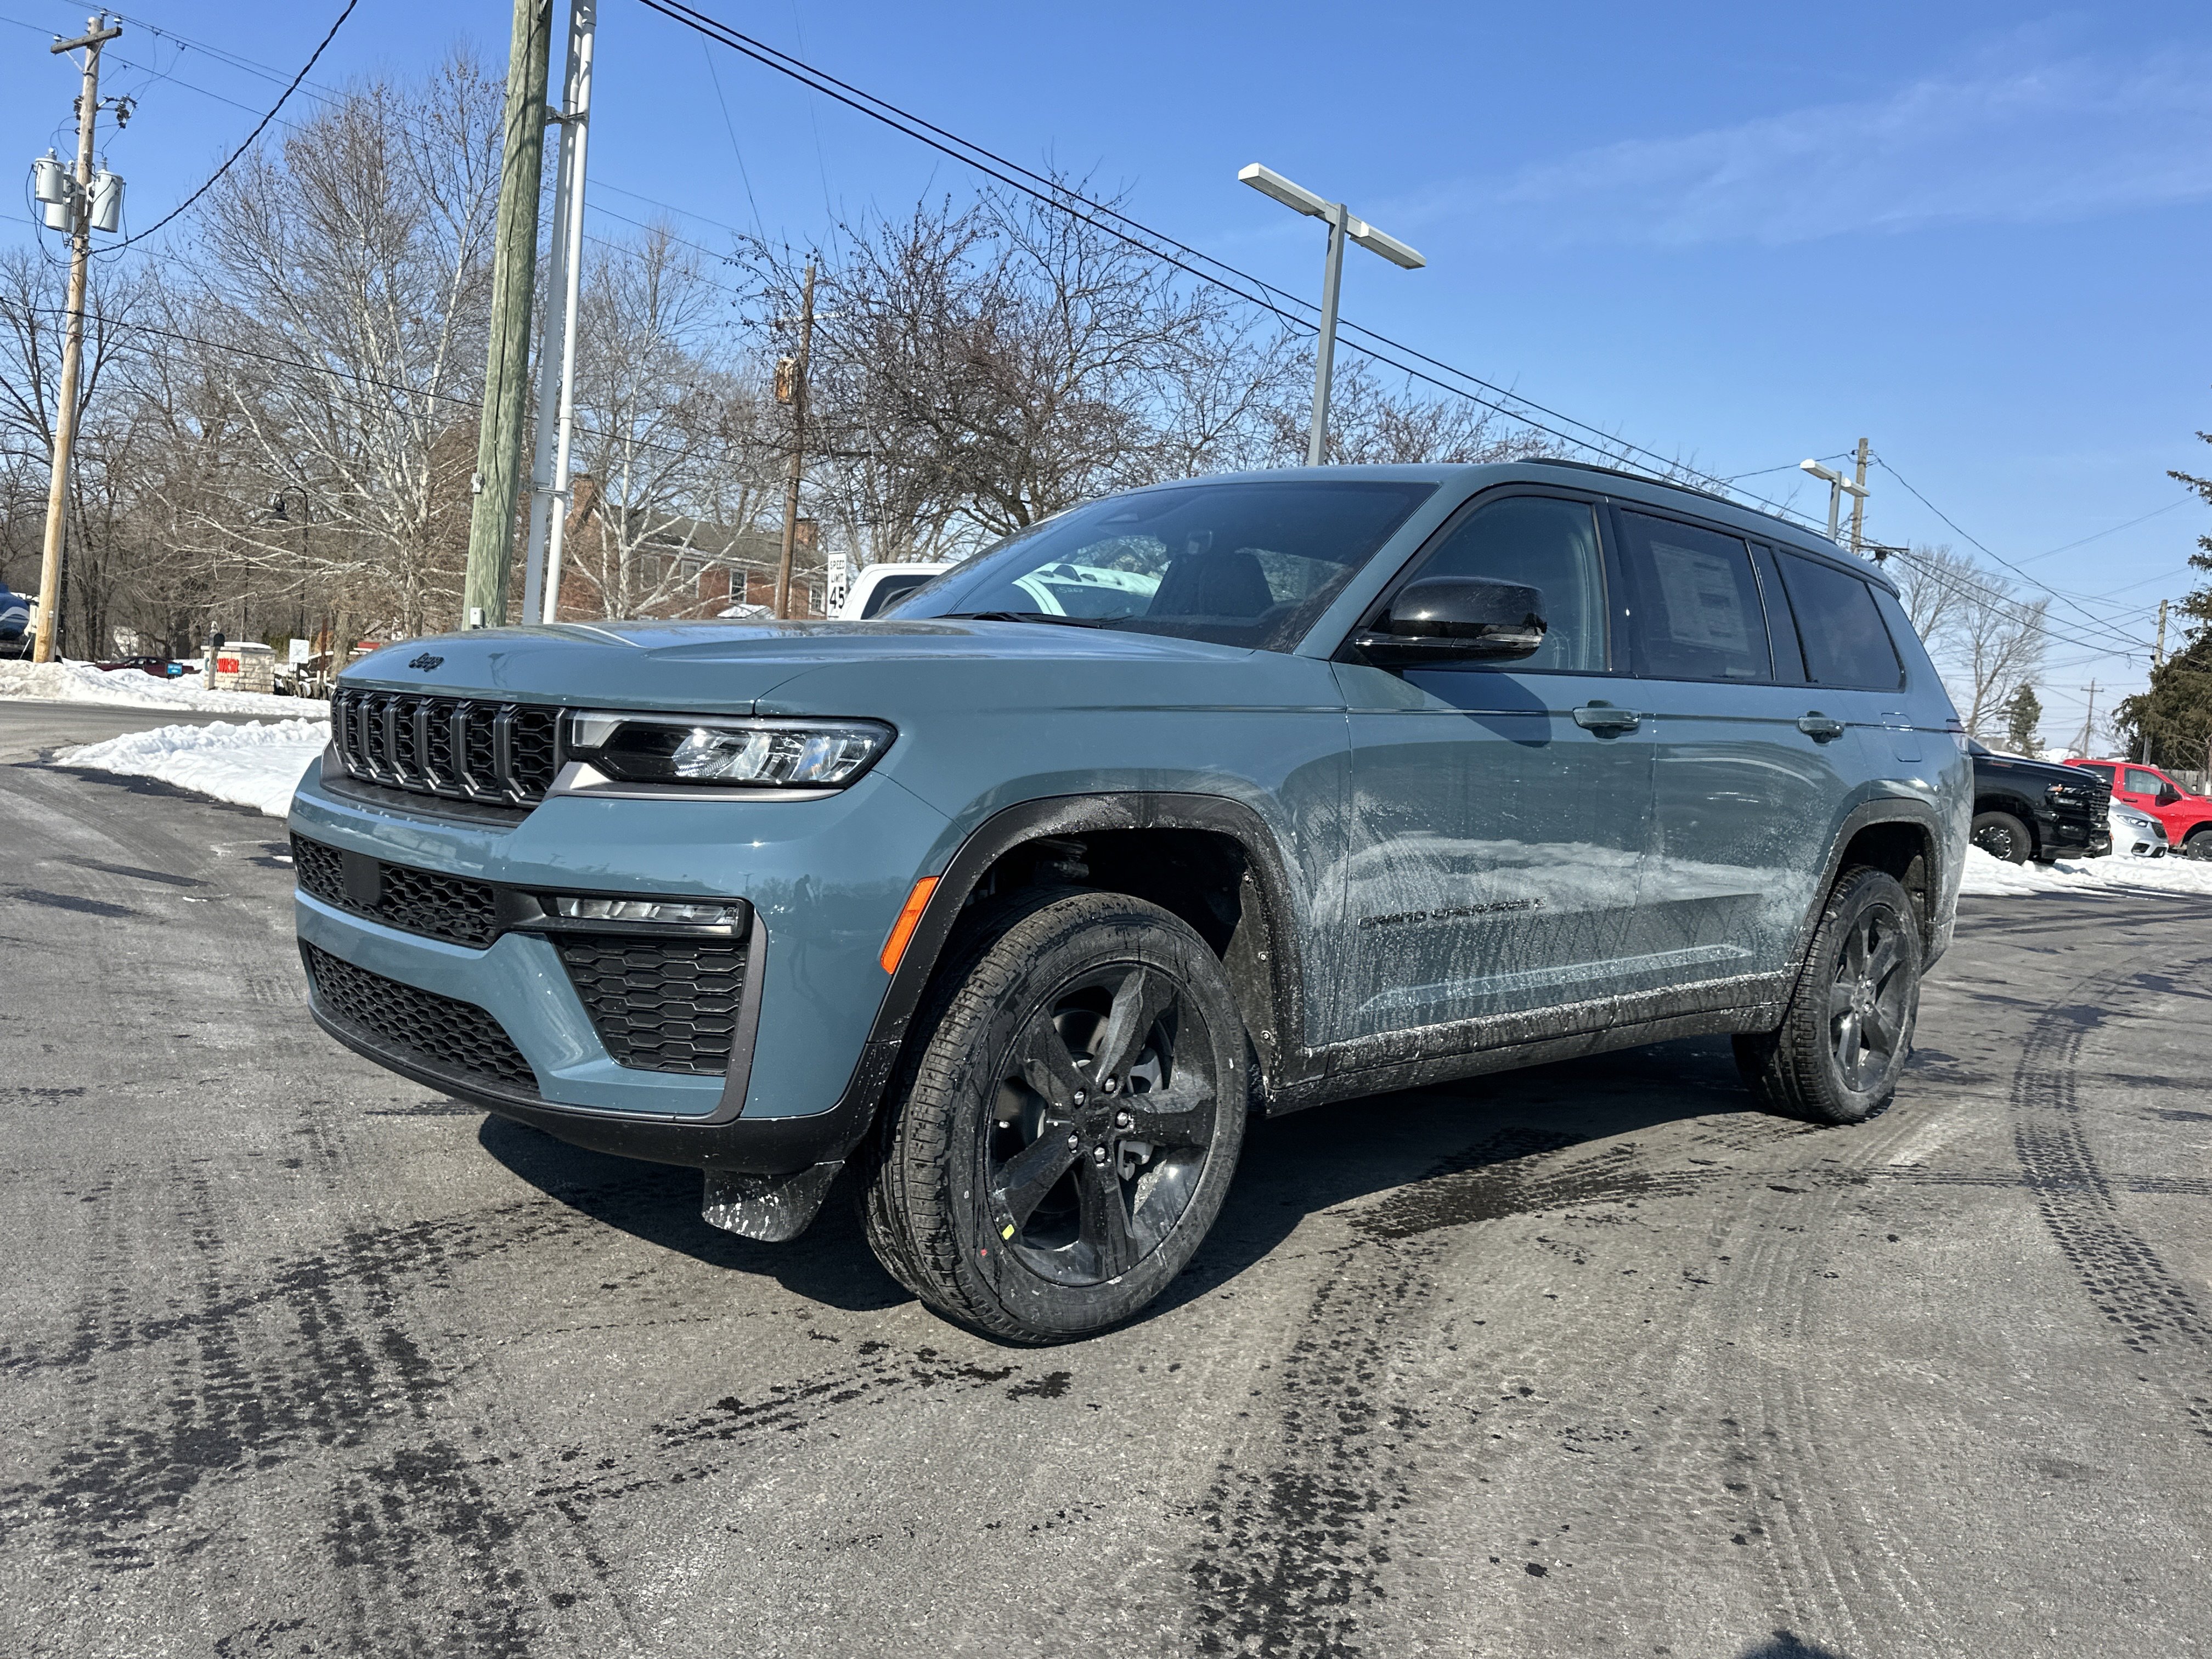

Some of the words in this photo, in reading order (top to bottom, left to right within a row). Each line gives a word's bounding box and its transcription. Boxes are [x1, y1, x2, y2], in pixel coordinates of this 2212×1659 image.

[830, 560, 845, 570] SPEED
[831, 573, 844, 583] LIMIT
[830, 586, 845, 609] 45
